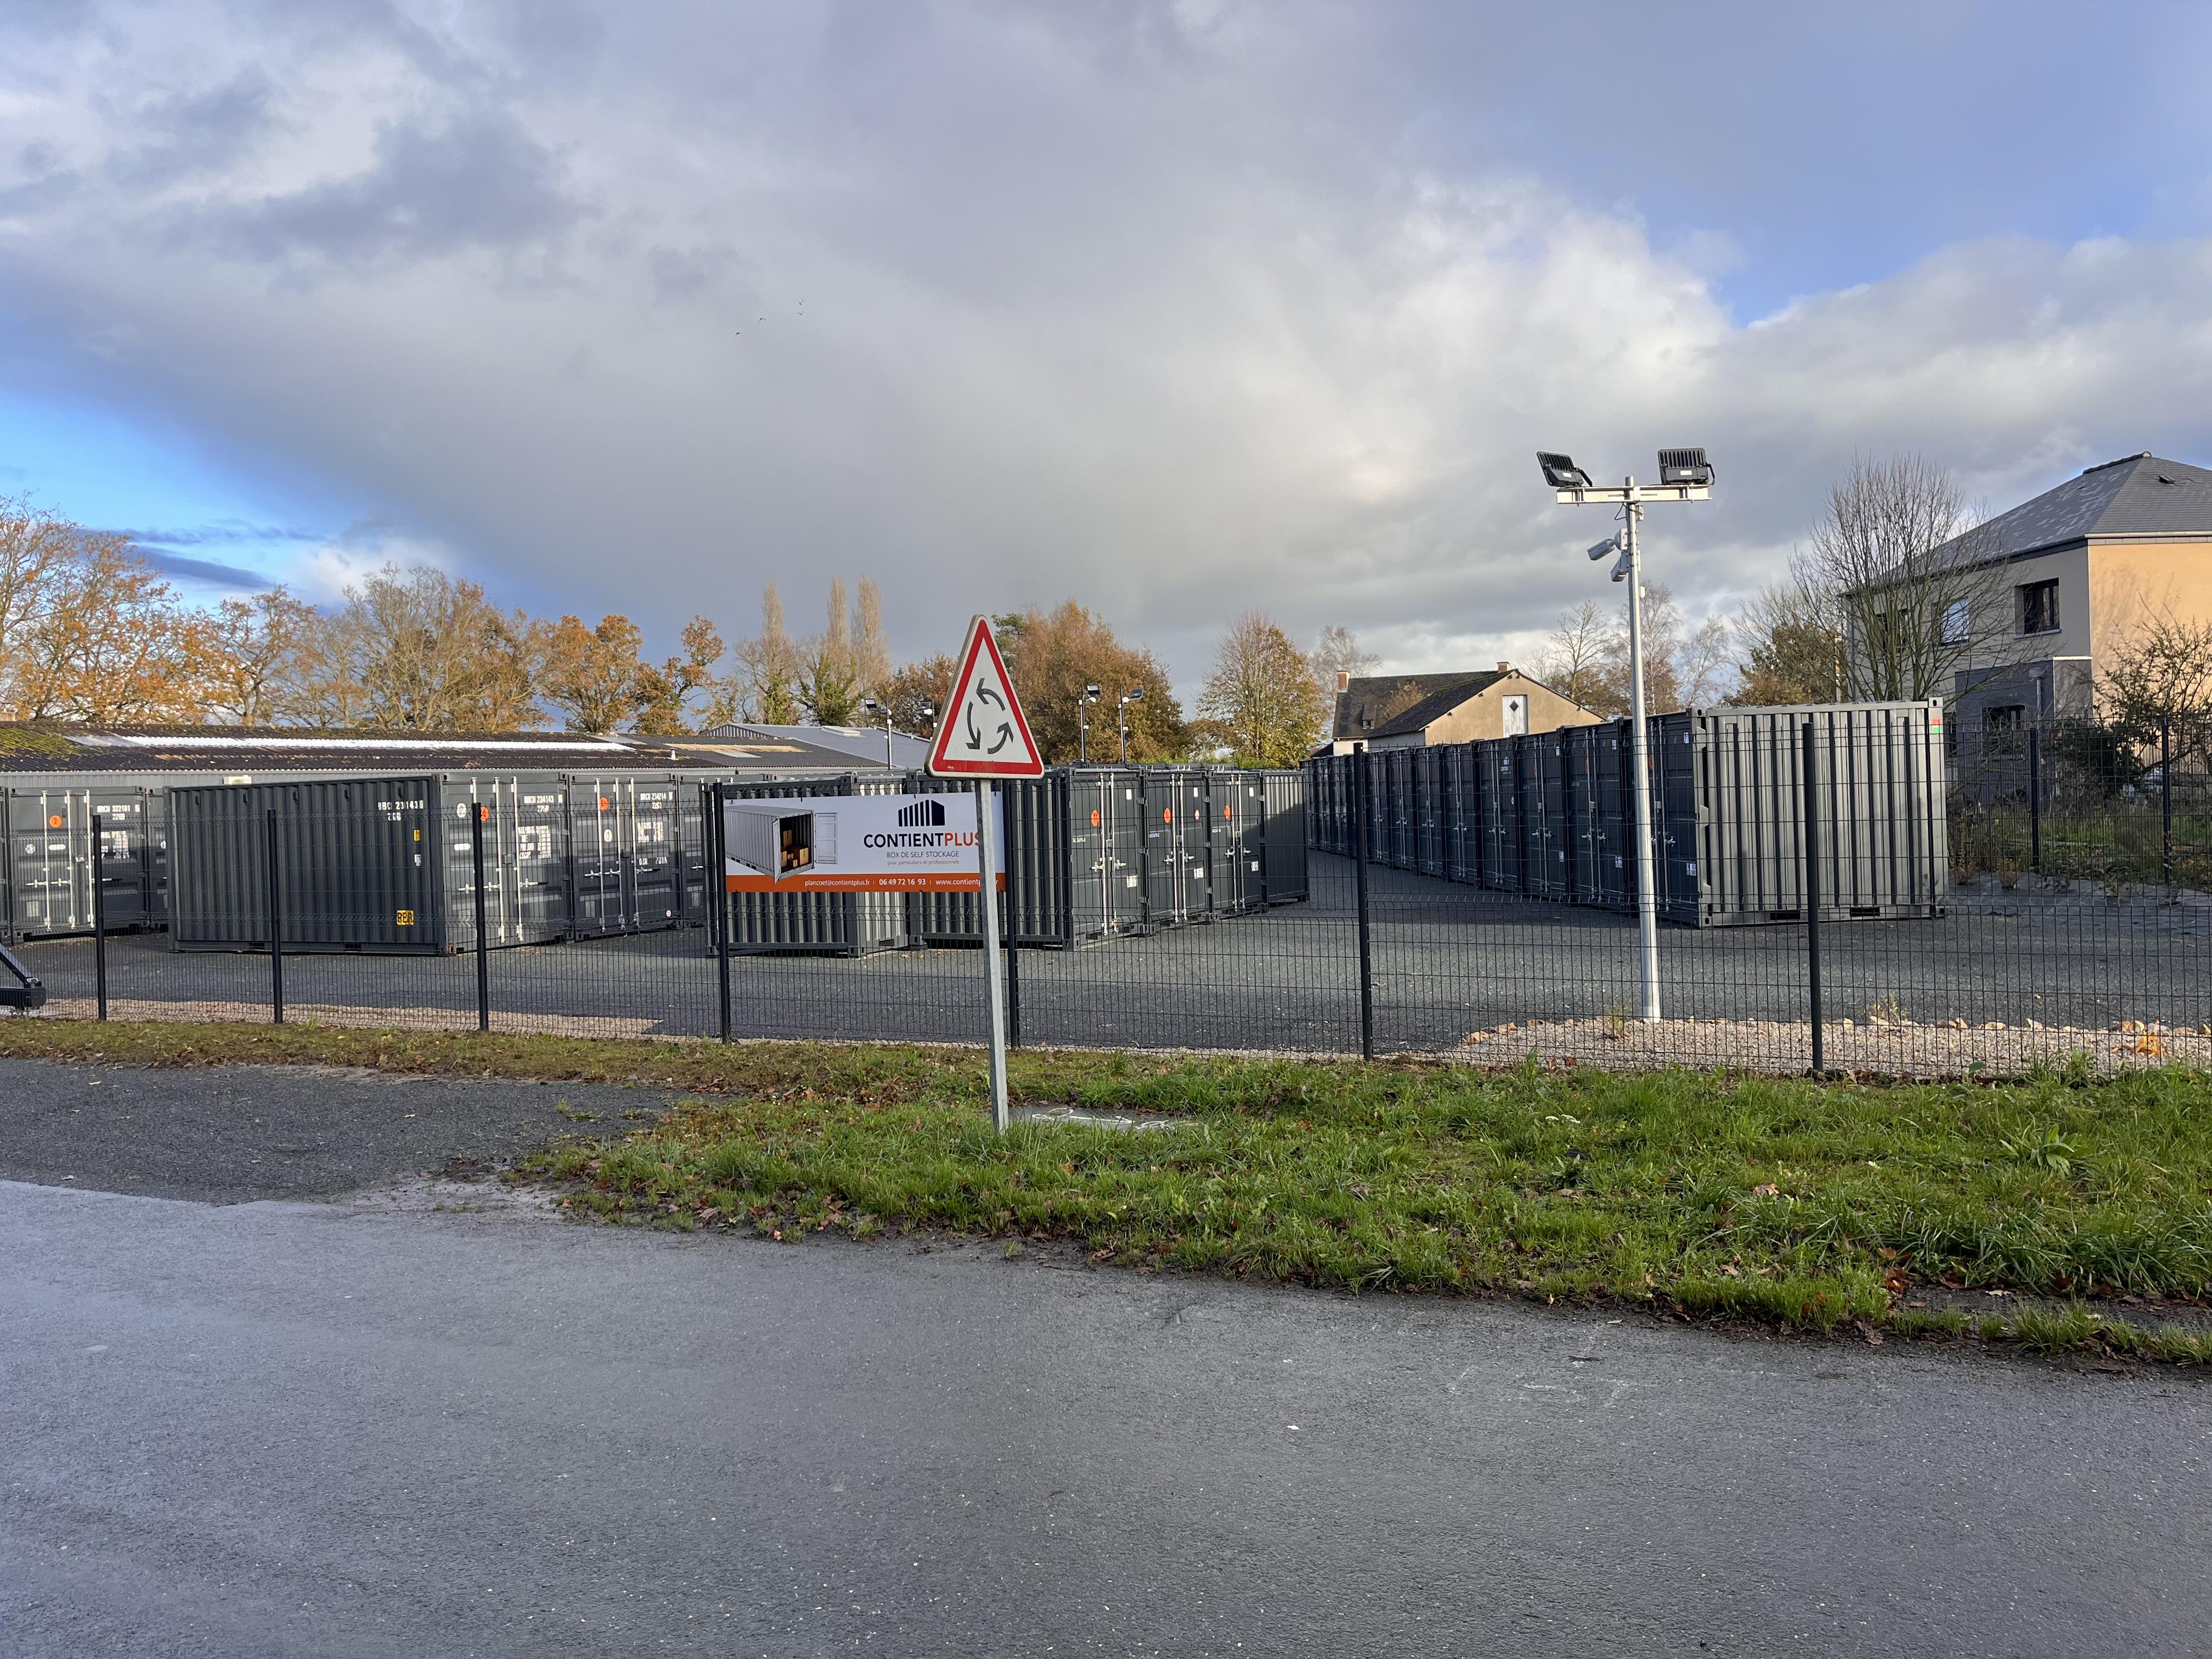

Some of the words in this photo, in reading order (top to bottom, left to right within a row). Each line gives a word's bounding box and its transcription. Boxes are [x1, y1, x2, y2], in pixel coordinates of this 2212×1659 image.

[537, 795, 554, 803] 234143
[651, 792, 667, 800] 234214
[378, 802, 392, 810] BBC
[395, 801, 418, 810] 23143
[804, 879, 870, 887] plancoet@contientplus.fr
